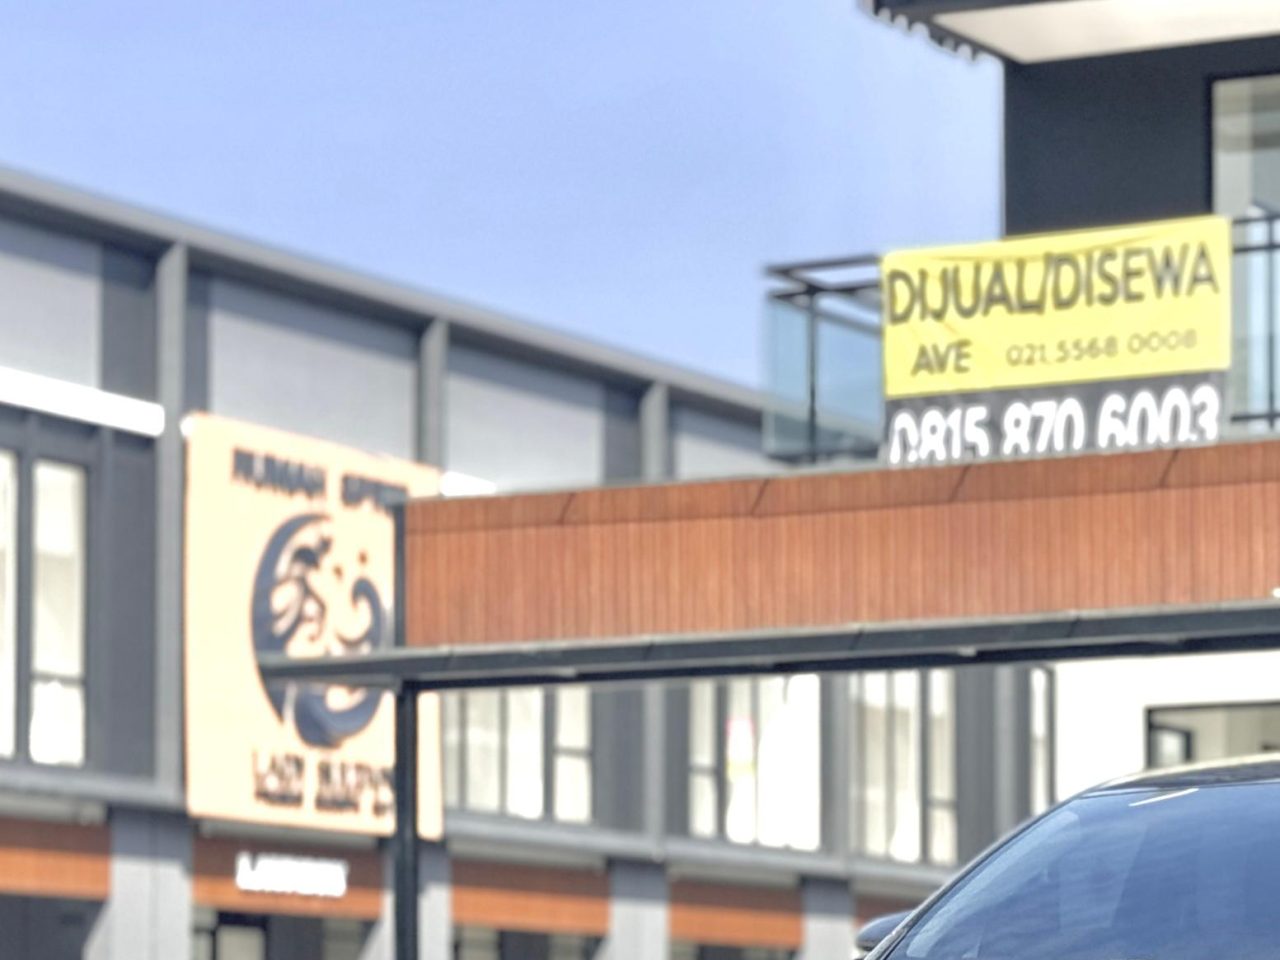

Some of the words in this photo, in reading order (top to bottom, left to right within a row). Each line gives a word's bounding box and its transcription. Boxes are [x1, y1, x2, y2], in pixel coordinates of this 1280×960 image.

[910, 340, 973, 378] AVE
[889, 405, 990, 465] 0815
[1002, 396, 1086, 455] 870
[1097, 384, 1220, 449] 6003
